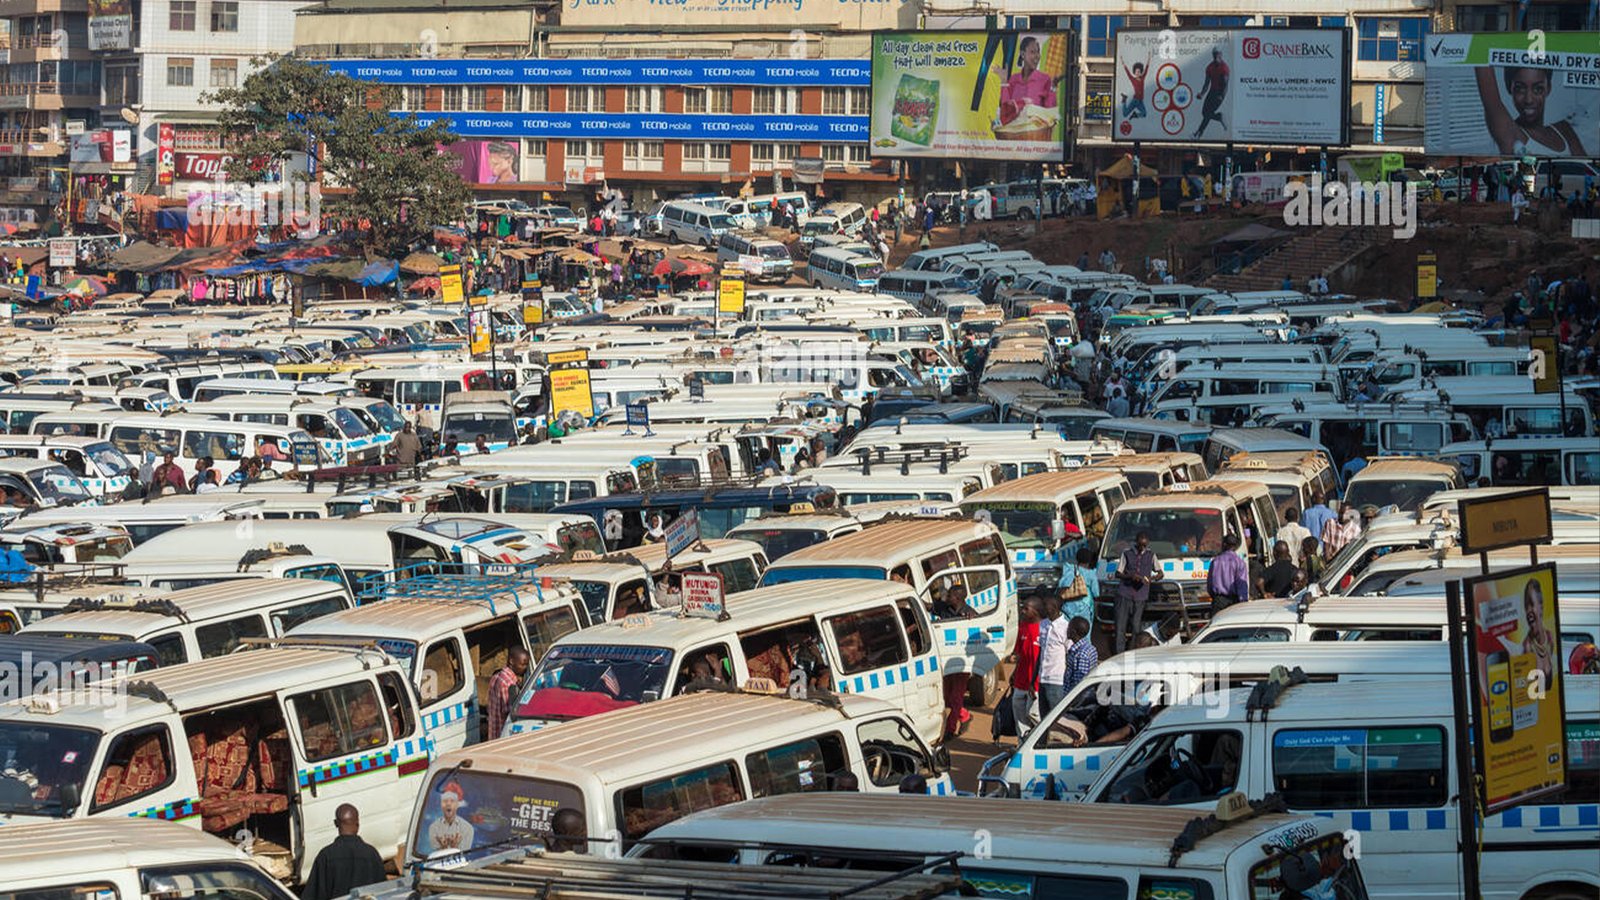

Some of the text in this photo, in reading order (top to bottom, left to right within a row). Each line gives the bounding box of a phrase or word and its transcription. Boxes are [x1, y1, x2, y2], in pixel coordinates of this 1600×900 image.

[1188, 35, 1212, 44] Crane
[1212, 34, 1229, 43] Bank
[882, 40, 978, 56] All day clean and fresh
[1441, 45, 1464, 56] Rexona
[894, 54, 966, 69] that will amaze.
[1491, 51, 1519, 64] FEEL
[1521, 52, 1562, 68] CLEAN,
[1566, 56, 1590, 68] DRY
[358, 68, 381, 76] TECNO
[411, 68, 436, 76] TECNO
[466, 68, 492, 76] TECNO
[524, 68, 549, 77] TECNO
[582, 68, 608, 77] TECNO
[642, 68, 668, 77] TECNO
[703, 68, 731, 77] TECNO
[766, 68, 794, 77] TECNO
[830, 68, 860, 77] TECNO
[466, 120, 490, 128] TECNO
[524, 120, 548, 128] TECNO
[582, 120, 608, 129] TECNO
[640, 121, 668, 130] TECNO
[702, 122, 730, 130] TECNO
[766, 122, 794, 131] TECNO
[830, 123, 858, 132] TECNO
[748, 681, 770, 690] TAXI
[510, 818, 553, 832] THE BES
